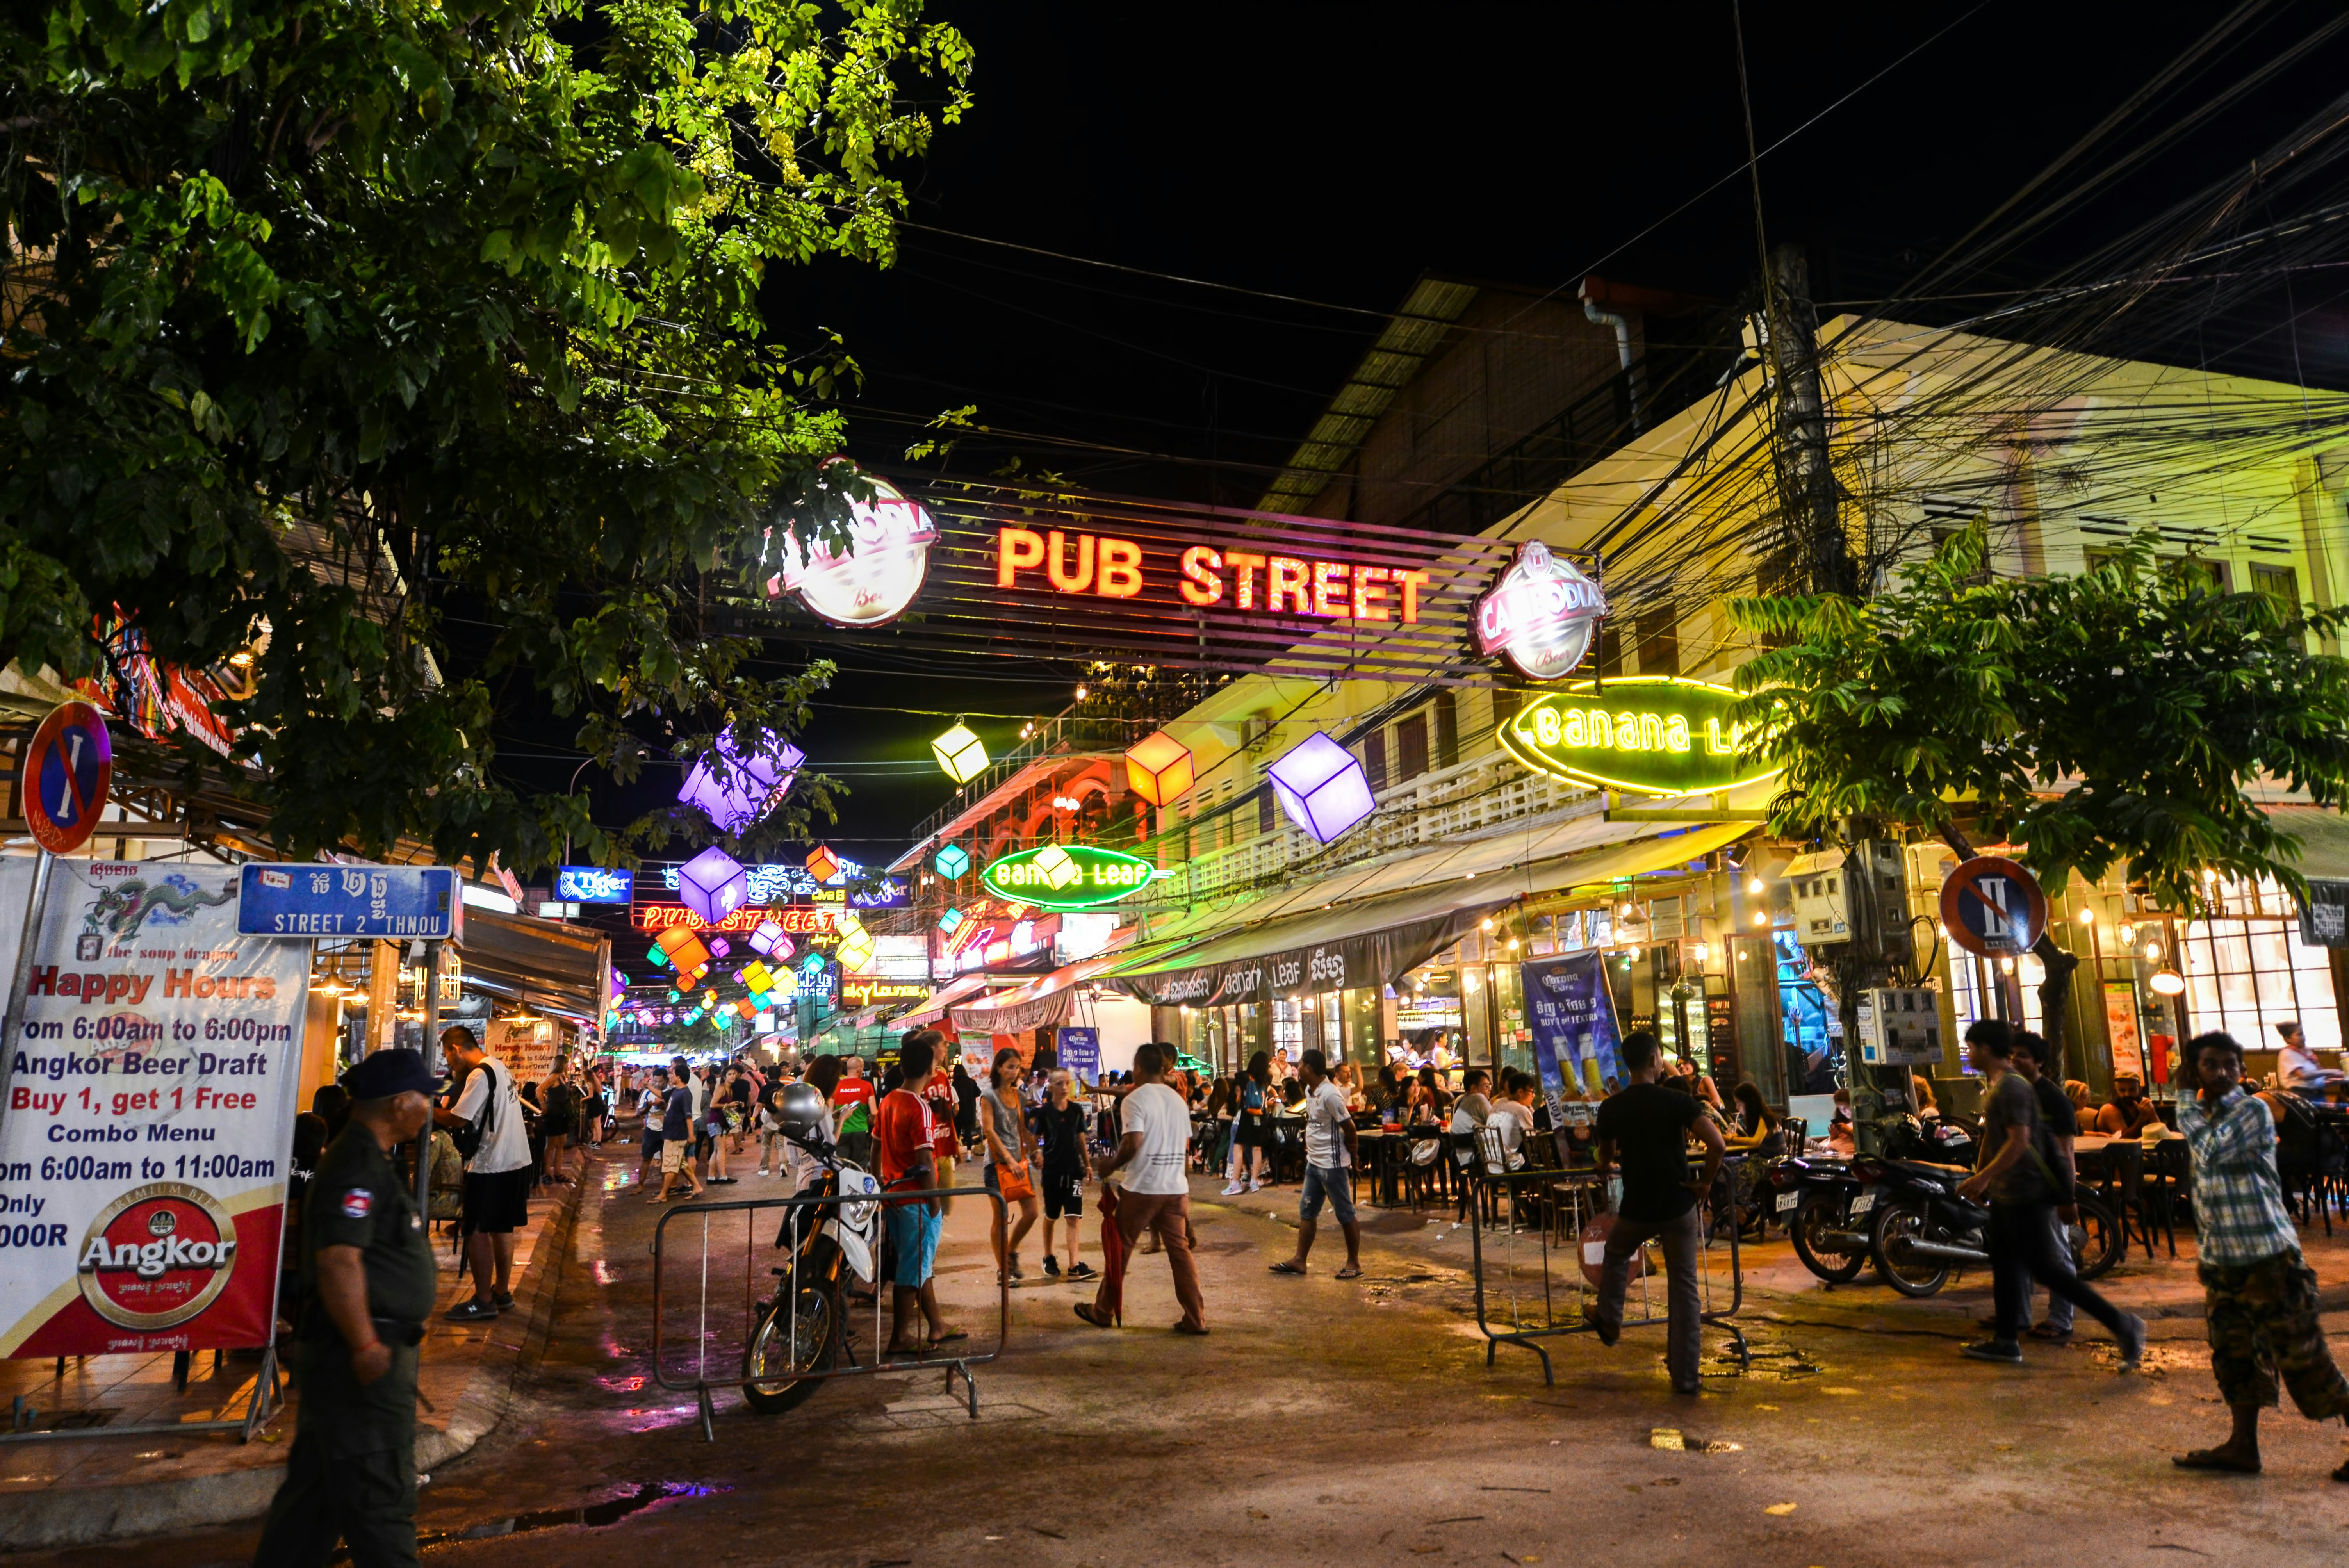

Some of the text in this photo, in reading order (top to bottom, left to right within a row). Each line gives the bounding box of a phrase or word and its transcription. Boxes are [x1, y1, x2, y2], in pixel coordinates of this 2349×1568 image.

[998, 527, 1429, 624] PUB STREET
[1483, 581, 1599, 640] CAODIA
[1536, 648, 1570, 668] Beer
[1532, 707, 1691, 753] Banana
[578, 871, 630, 897] Tiger
[996, 863, 1147, 886] Bana Leaf
[275, 914, 440, 934] STREET 2 THNOU
[644, 906, 705, 930] PUB
[107, 946, 238, 963] the soup dragon
[27, 965, 277, 1005] Happy Hours
[1272, 962, 1300, 988] Leaf
[1542, 973, 1579, 987] Corona
[73, 1016, 163, 1041] 6:00am
[173, 1019, 196, 1041] to
[205, 1017, 292, 1046] 6:00pm
[1541, 1017, 1554, 1026] BUY
[1555, 1017, 1560, 1026] 1
[1571, 1015, 1575, 1024] 1
[1576, 1012, 1598, 1024] EXTRA
[12, 1051, 267, 1082] Angkor Beer Draft
[11, 1087, 257, 1117] Buy 1, get 1 Free
[47, 1124, 216, 1143] Combo Menu
[41, 1155, 133, 1181] 6:00am
[141, 1156, 165, 1180] to
[174, 1154, 276, 1179] 11:00am
[1073, 1185, 1082, 1195] 76
[79, 1235, 237, 1279] Angkor
